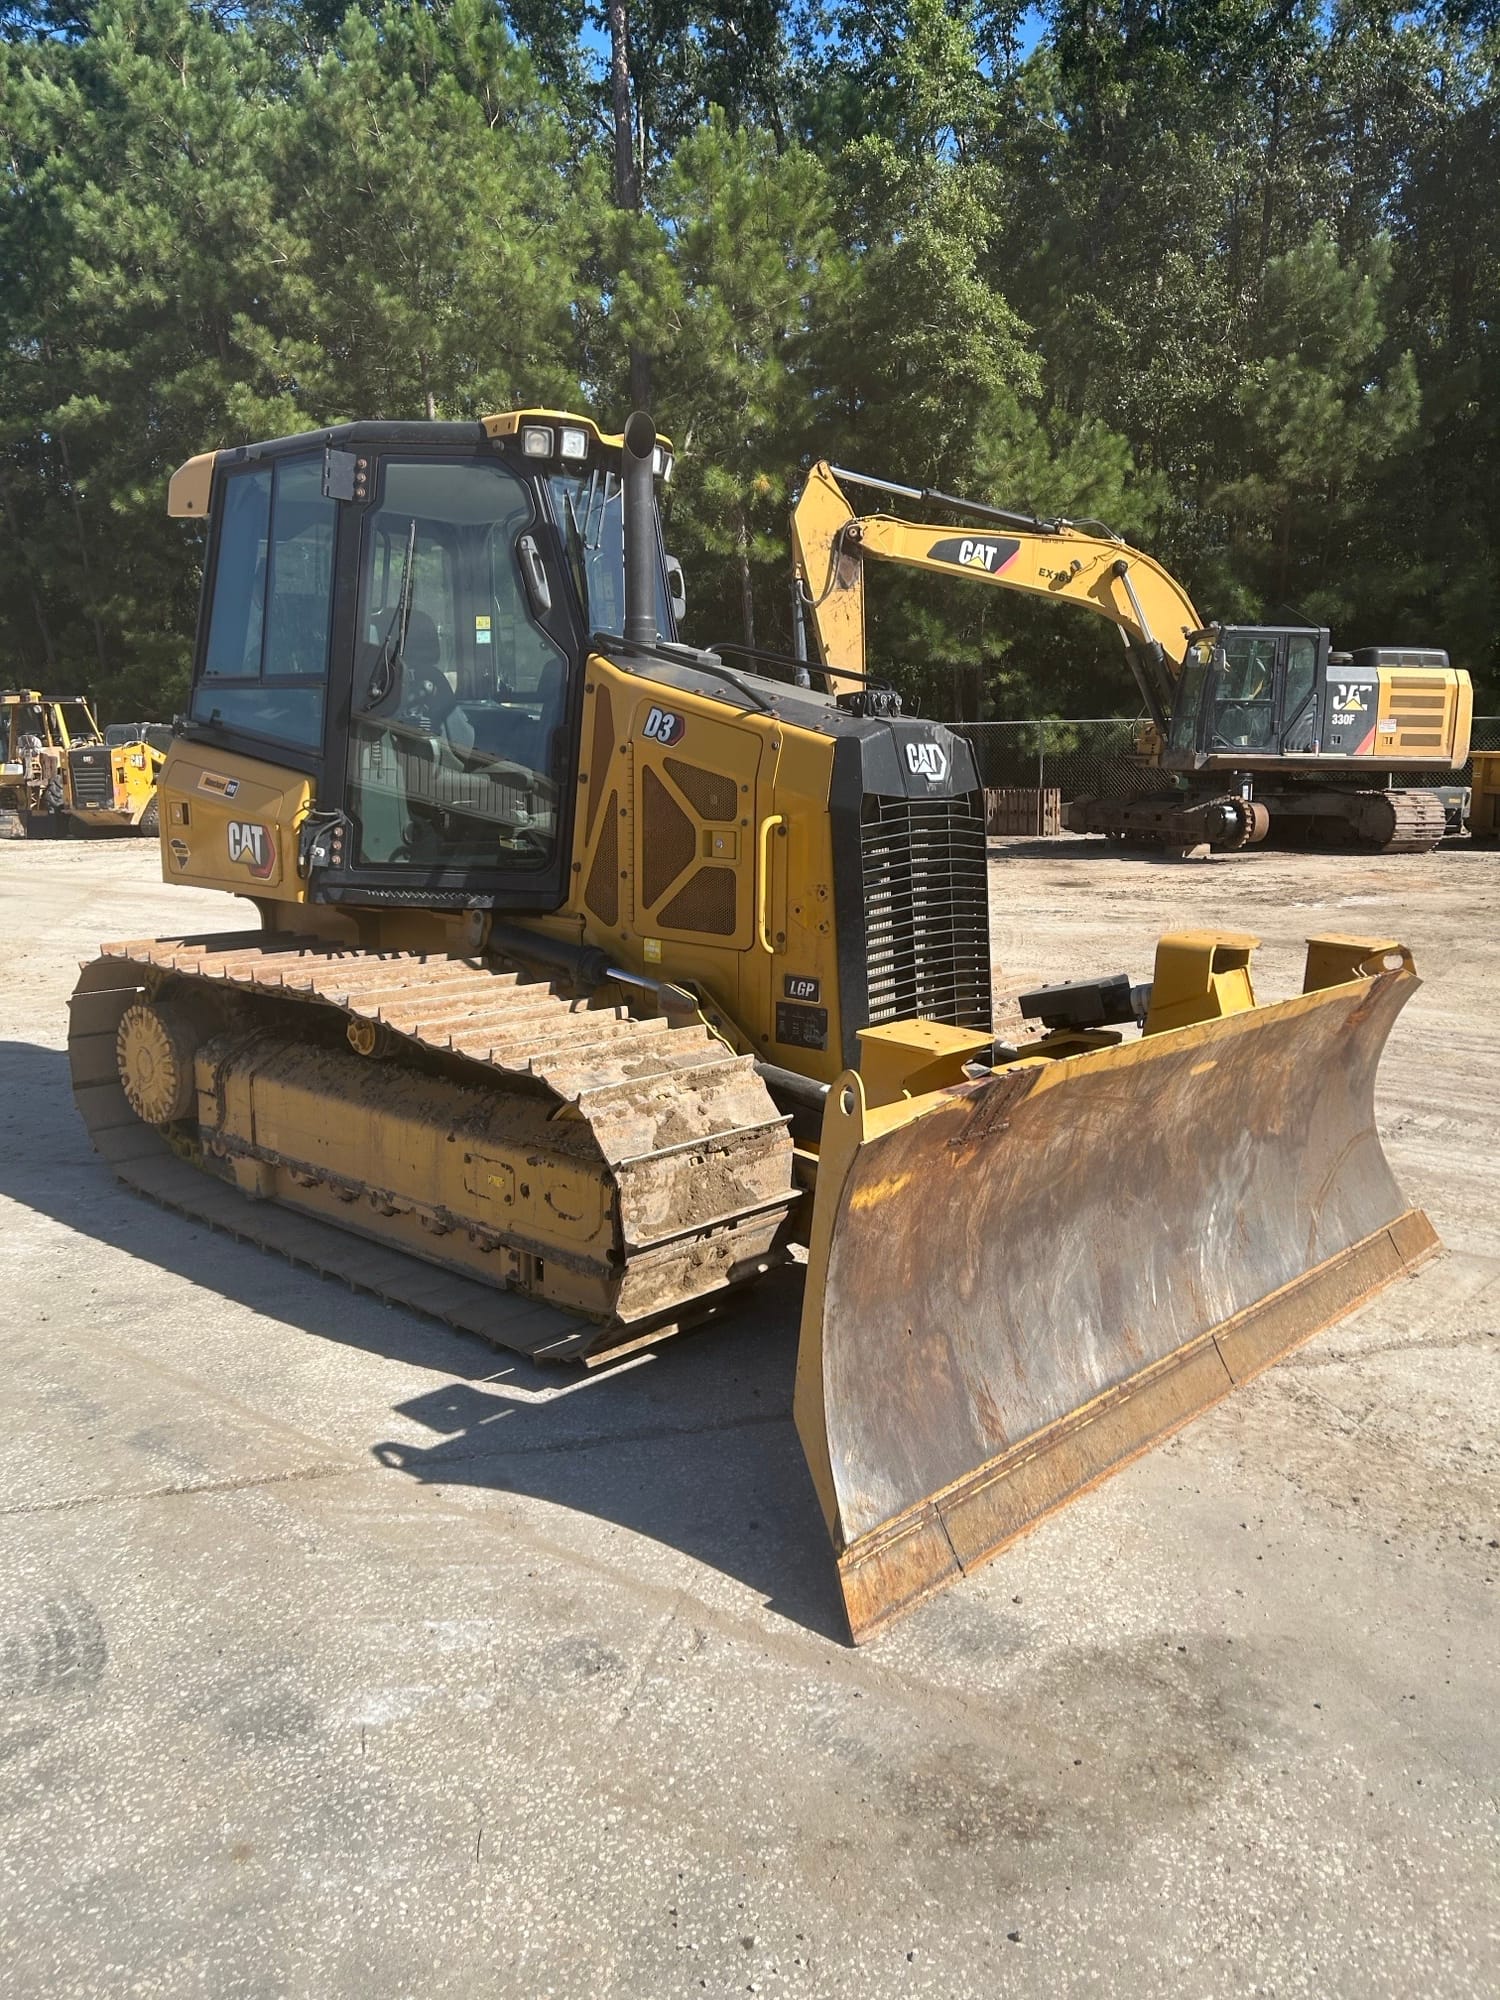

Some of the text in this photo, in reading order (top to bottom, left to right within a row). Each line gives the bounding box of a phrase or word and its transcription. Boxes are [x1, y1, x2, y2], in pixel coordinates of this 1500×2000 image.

[959, 540, 998, 571] CAT
[643, 708, 676, 742] D3
[1331, 713, 1356, 725] 330F
[906, 743, 938, 773] CAT
[228, 822, 263, 865] CAT
[789, 979, 816, 998] LGP
